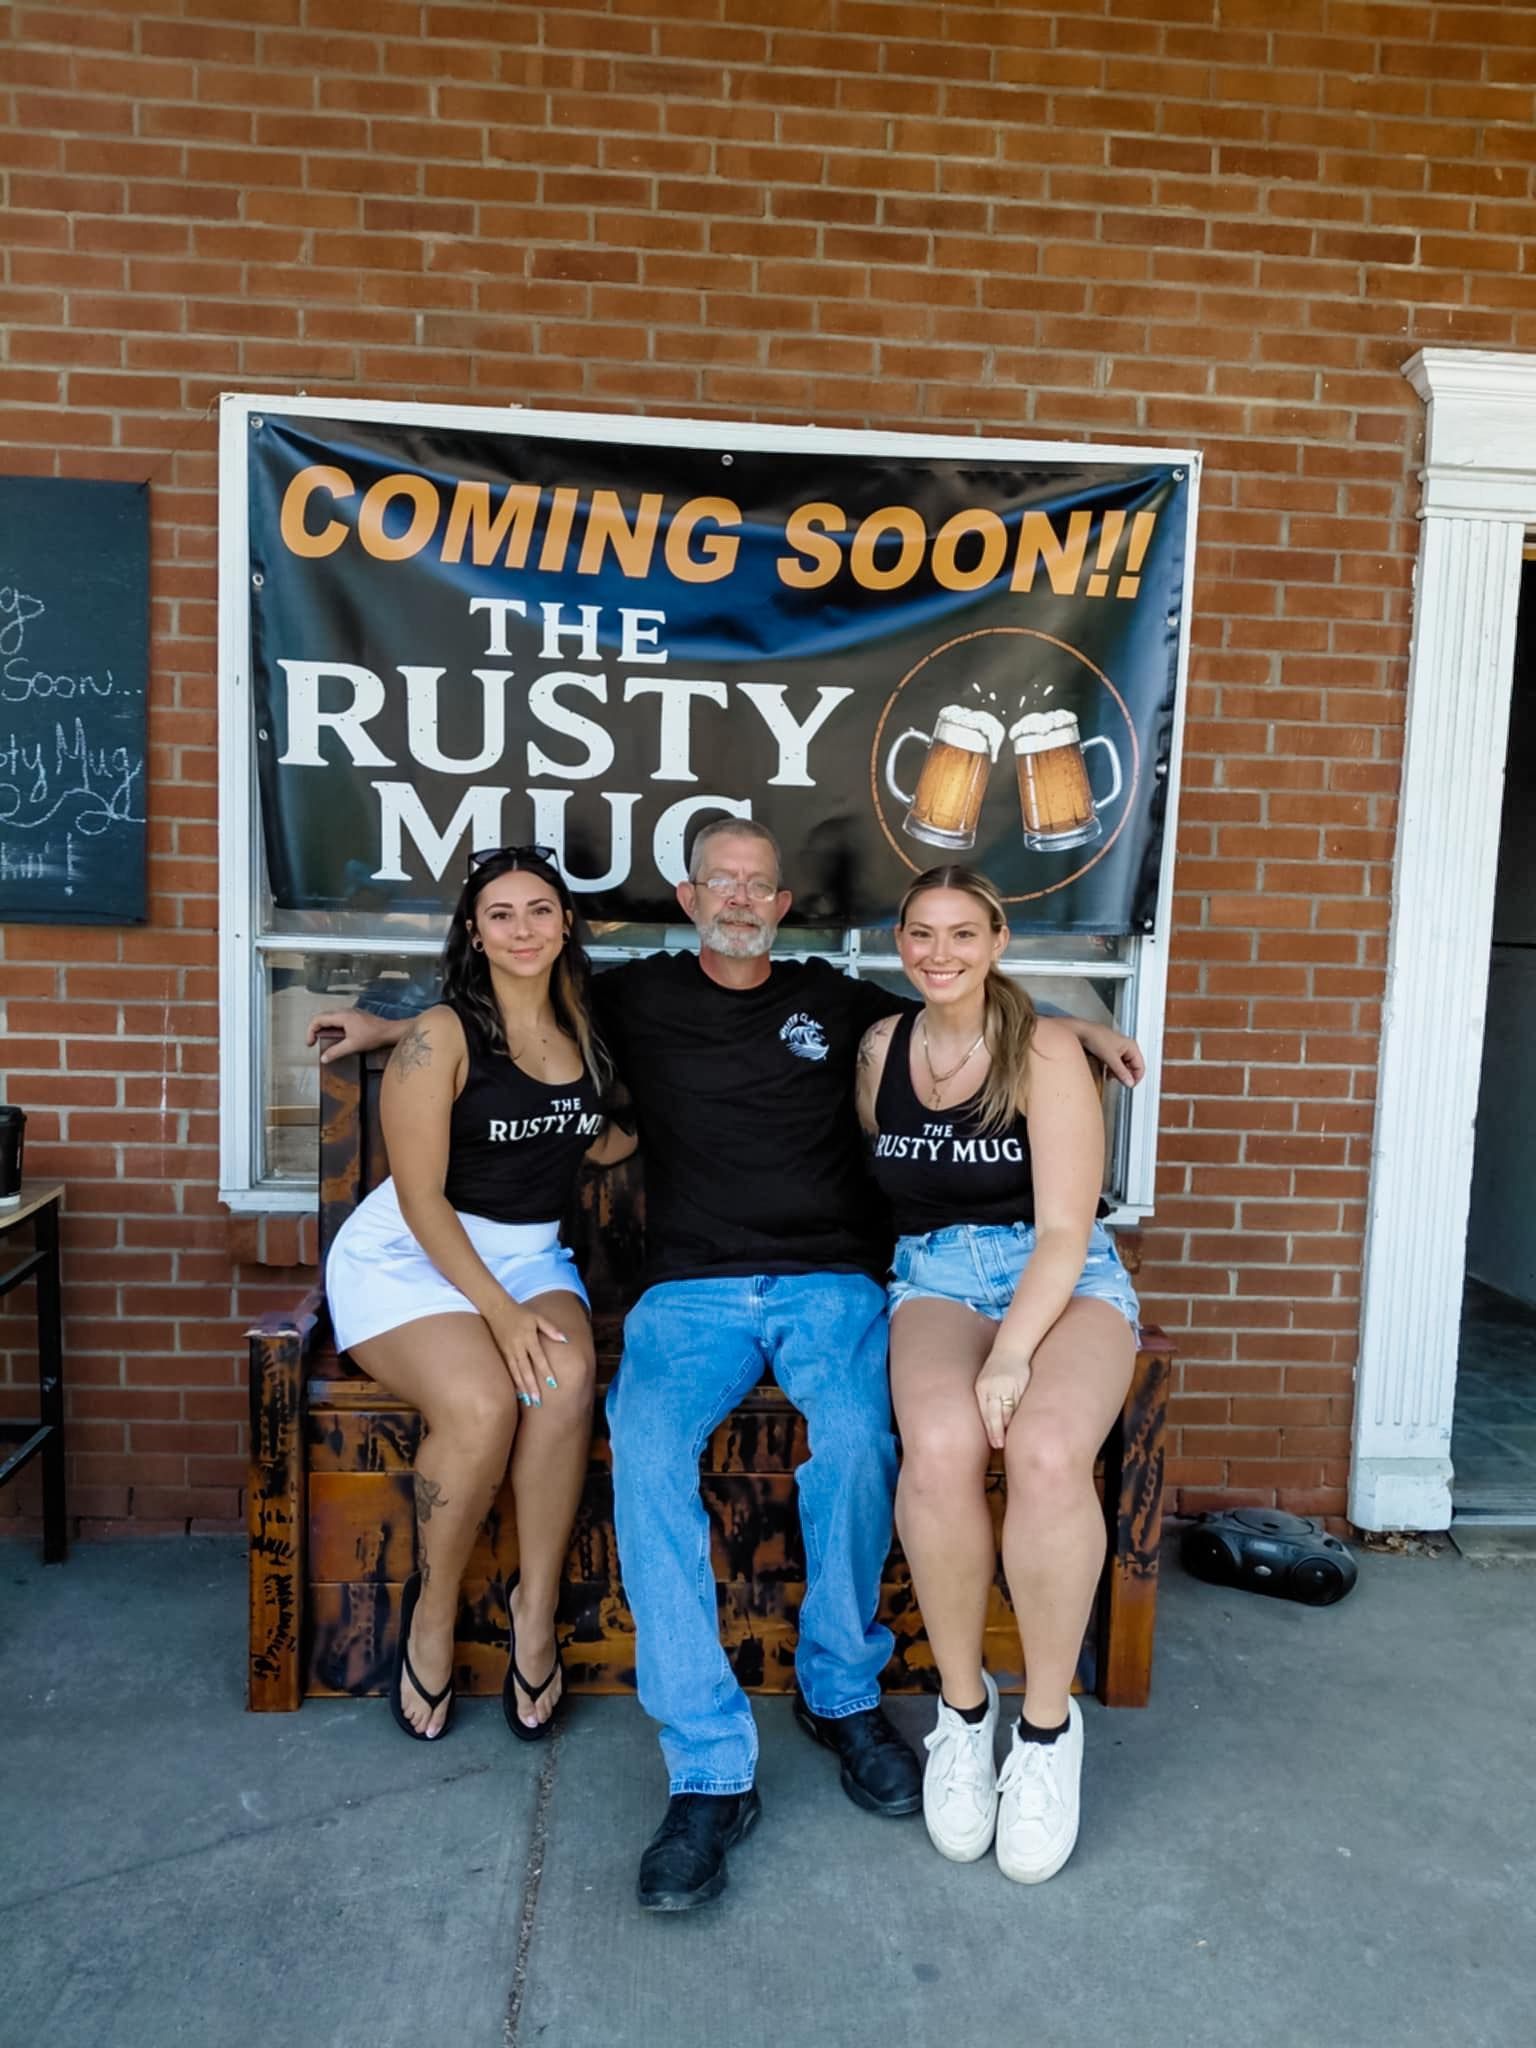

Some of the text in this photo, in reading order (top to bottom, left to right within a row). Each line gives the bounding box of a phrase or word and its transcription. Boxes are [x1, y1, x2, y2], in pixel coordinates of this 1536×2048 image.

[280, 465, 1157, 599] COMING SOON!!
[469, 597, 669, 664] THE
[276, 659, 855, 787] RUSTY
[55, 716, 143, 818] Mug
[488, 1114, 574, 1142] RUSTY
[551, 1098, 582, 1112] THE
[875, 1134, 1023, 1162] RUSTY MUG
[923, 1123, 953, 1137] THE
